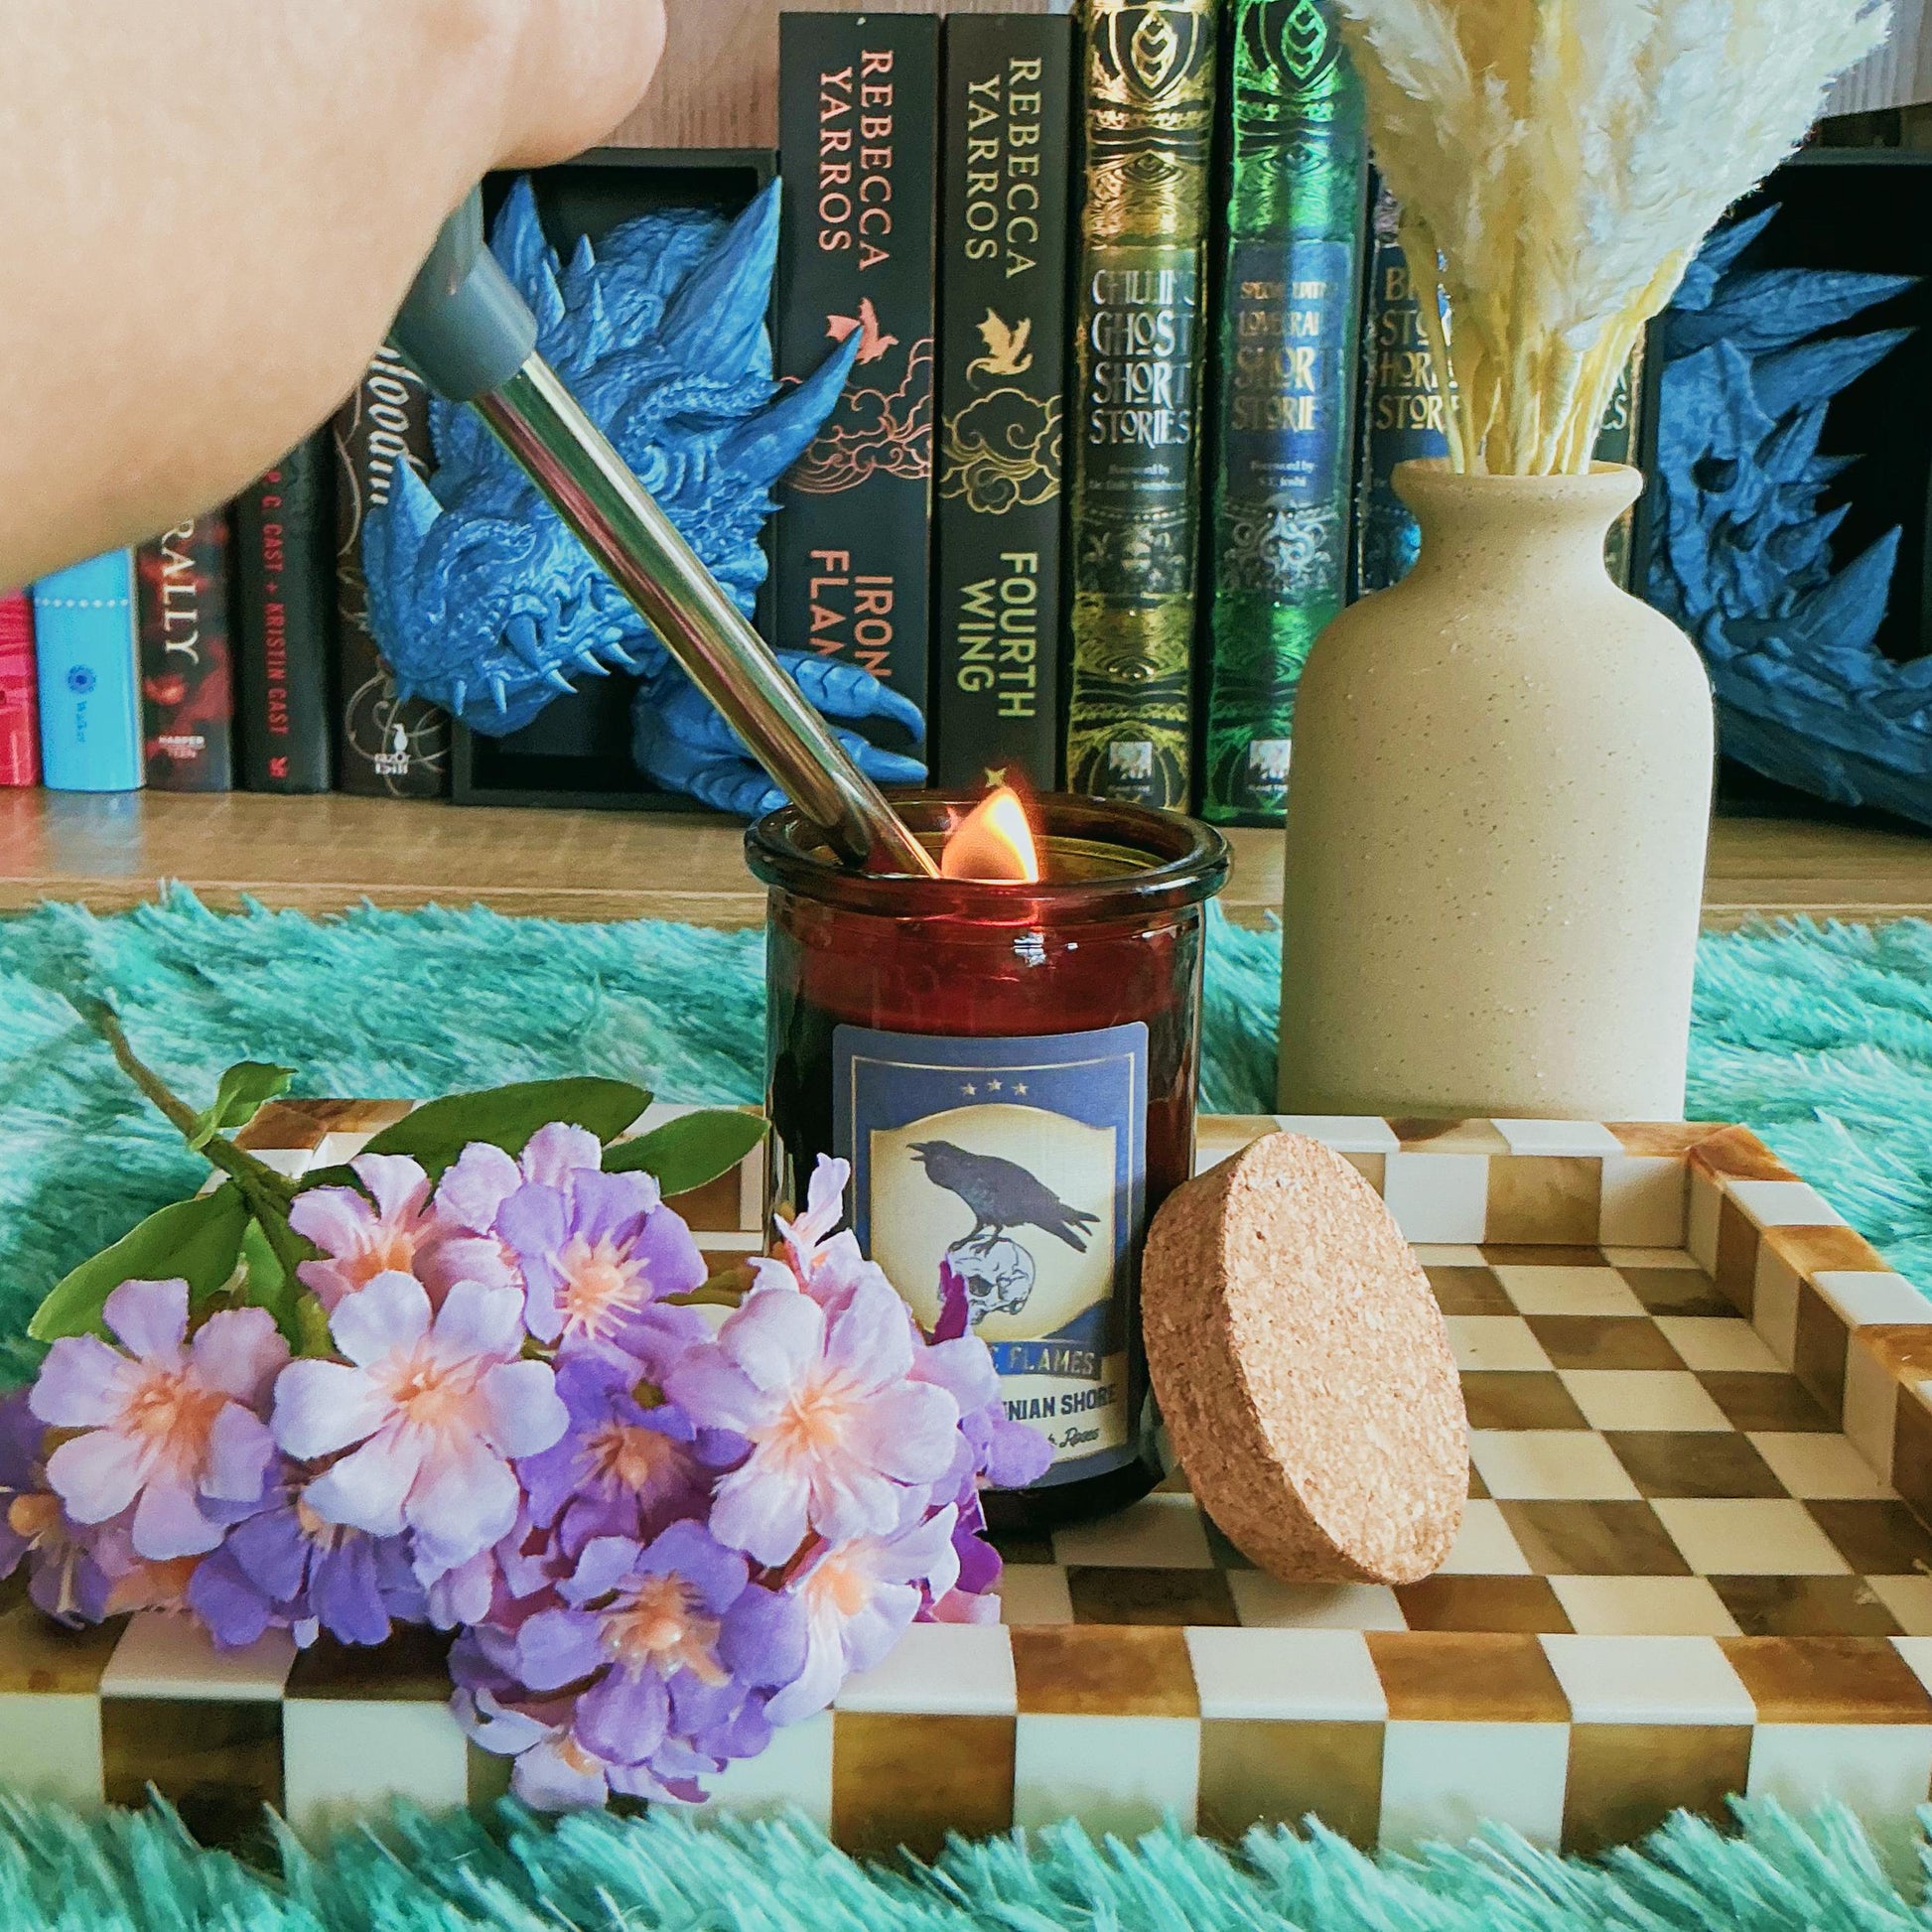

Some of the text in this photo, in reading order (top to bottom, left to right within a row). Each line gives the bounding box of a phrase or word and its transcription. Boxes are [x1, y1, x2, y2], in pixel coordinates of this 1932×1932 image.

[818, 68, 853, 251] YARROS
[859, 50, 893, 271] REBECCA
[965, 74, 1000, 260] YARROS
[1006, 57, 1041, 279] REBECCA
[1092, 310, 1195, 356] GHOST
[1091, 409, 1191, 449] STORIES
[1092, 361, 1192, 409] SHORT
[262, 523, 284, 573] CAST
[264, 602, 287, 680] KRISTIN
[854, 576, 894, 675] IRON
[958, 579, 996, 693] WING
[999, 552, 1037, 717] FOURTH
[268, 688, 289, 735] CAST
[1009, 1346, 1095, 1375] FLAMES
